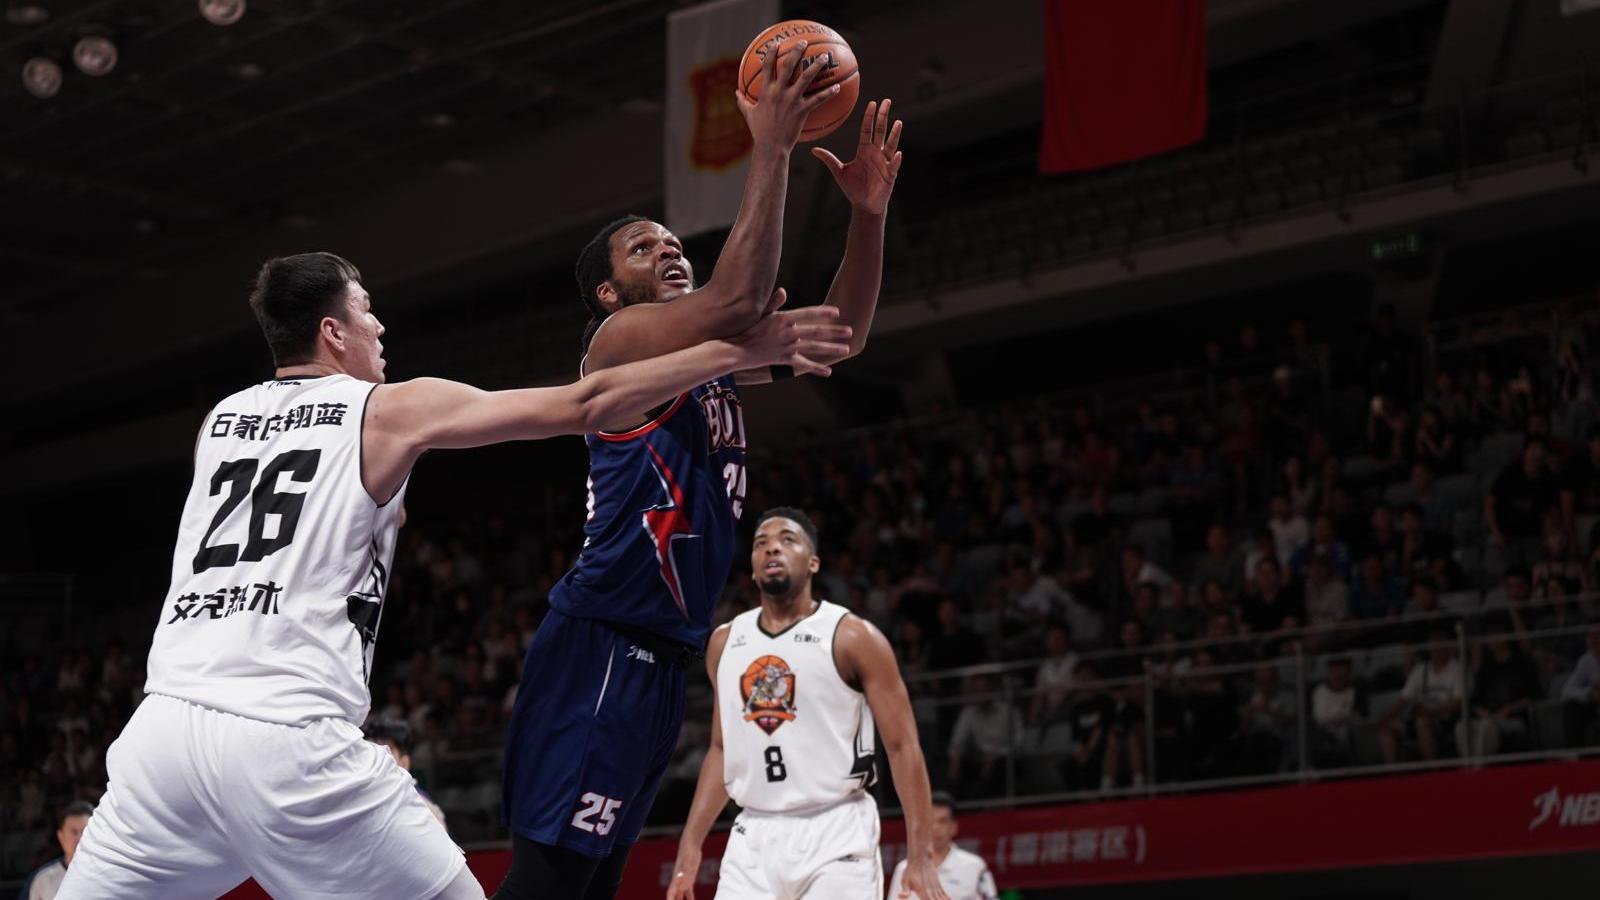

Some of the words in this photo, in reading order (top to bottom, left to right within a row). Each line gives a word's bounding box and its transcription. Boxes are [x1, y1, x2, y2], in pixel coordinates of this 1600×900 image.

[802, 50, 839, 70] NL
[210, 403, 348, 441] 石家庄翔蓝
[192, 448, 322, 574] 26
[167, 581, 284, 624] 艾克热木
[764, 746, 787, 783] 8
[570, 791, 623, 836] 25
